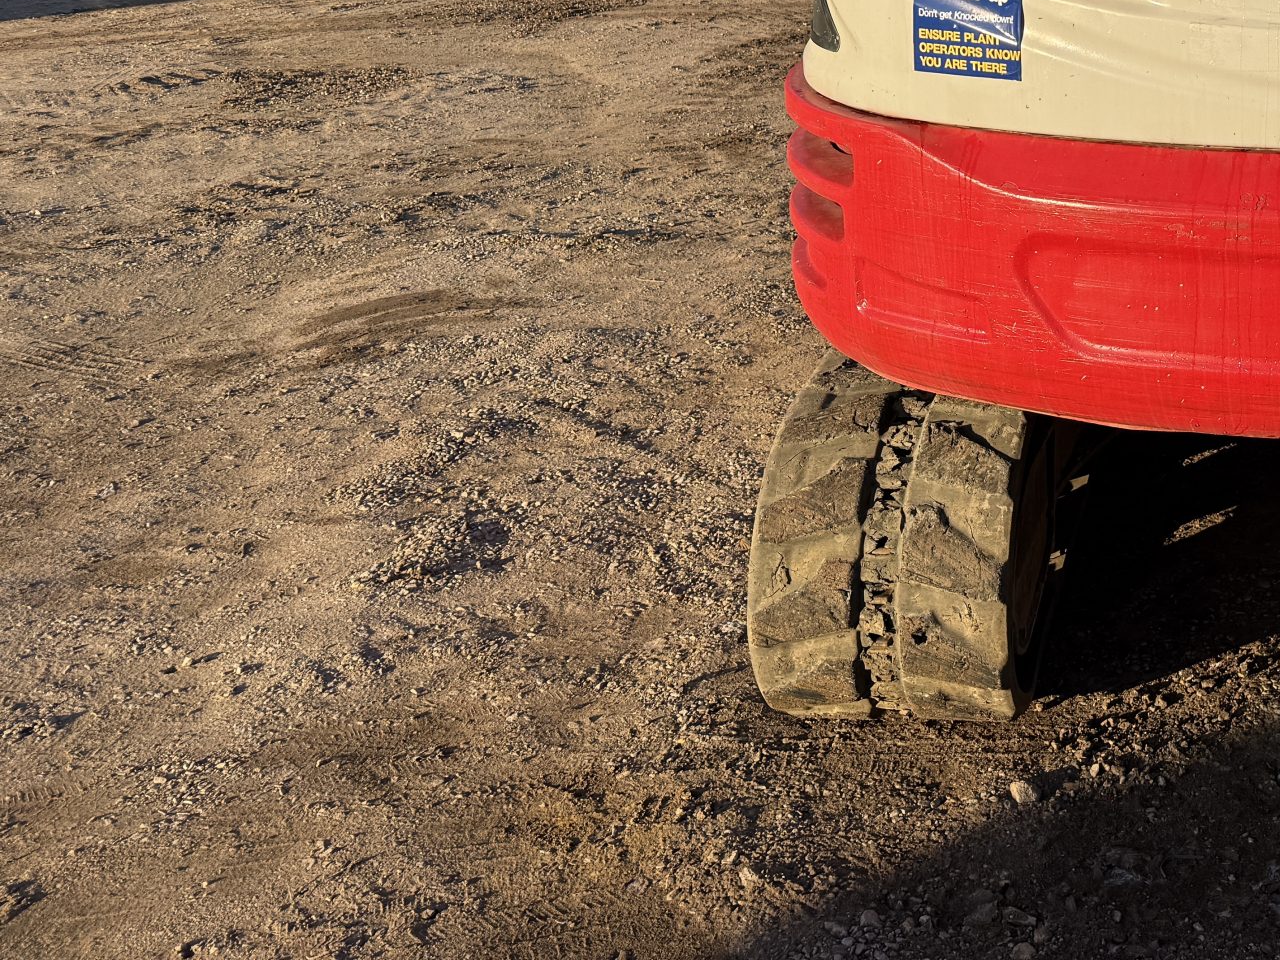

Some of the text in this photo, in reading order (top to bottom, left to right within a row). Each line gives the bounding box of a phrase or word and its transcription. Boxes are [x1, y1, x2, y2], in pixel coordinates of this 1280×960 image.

[939, 11, 952, 20] get
[954, 11, 988, 23] Knocked
[919, 27, 1000, 46] ENSURE PLANT
[919, 42, 1020, 61] OPERATORS KNOW
[920, 56, 1007, 75] YOU ARE THERE
